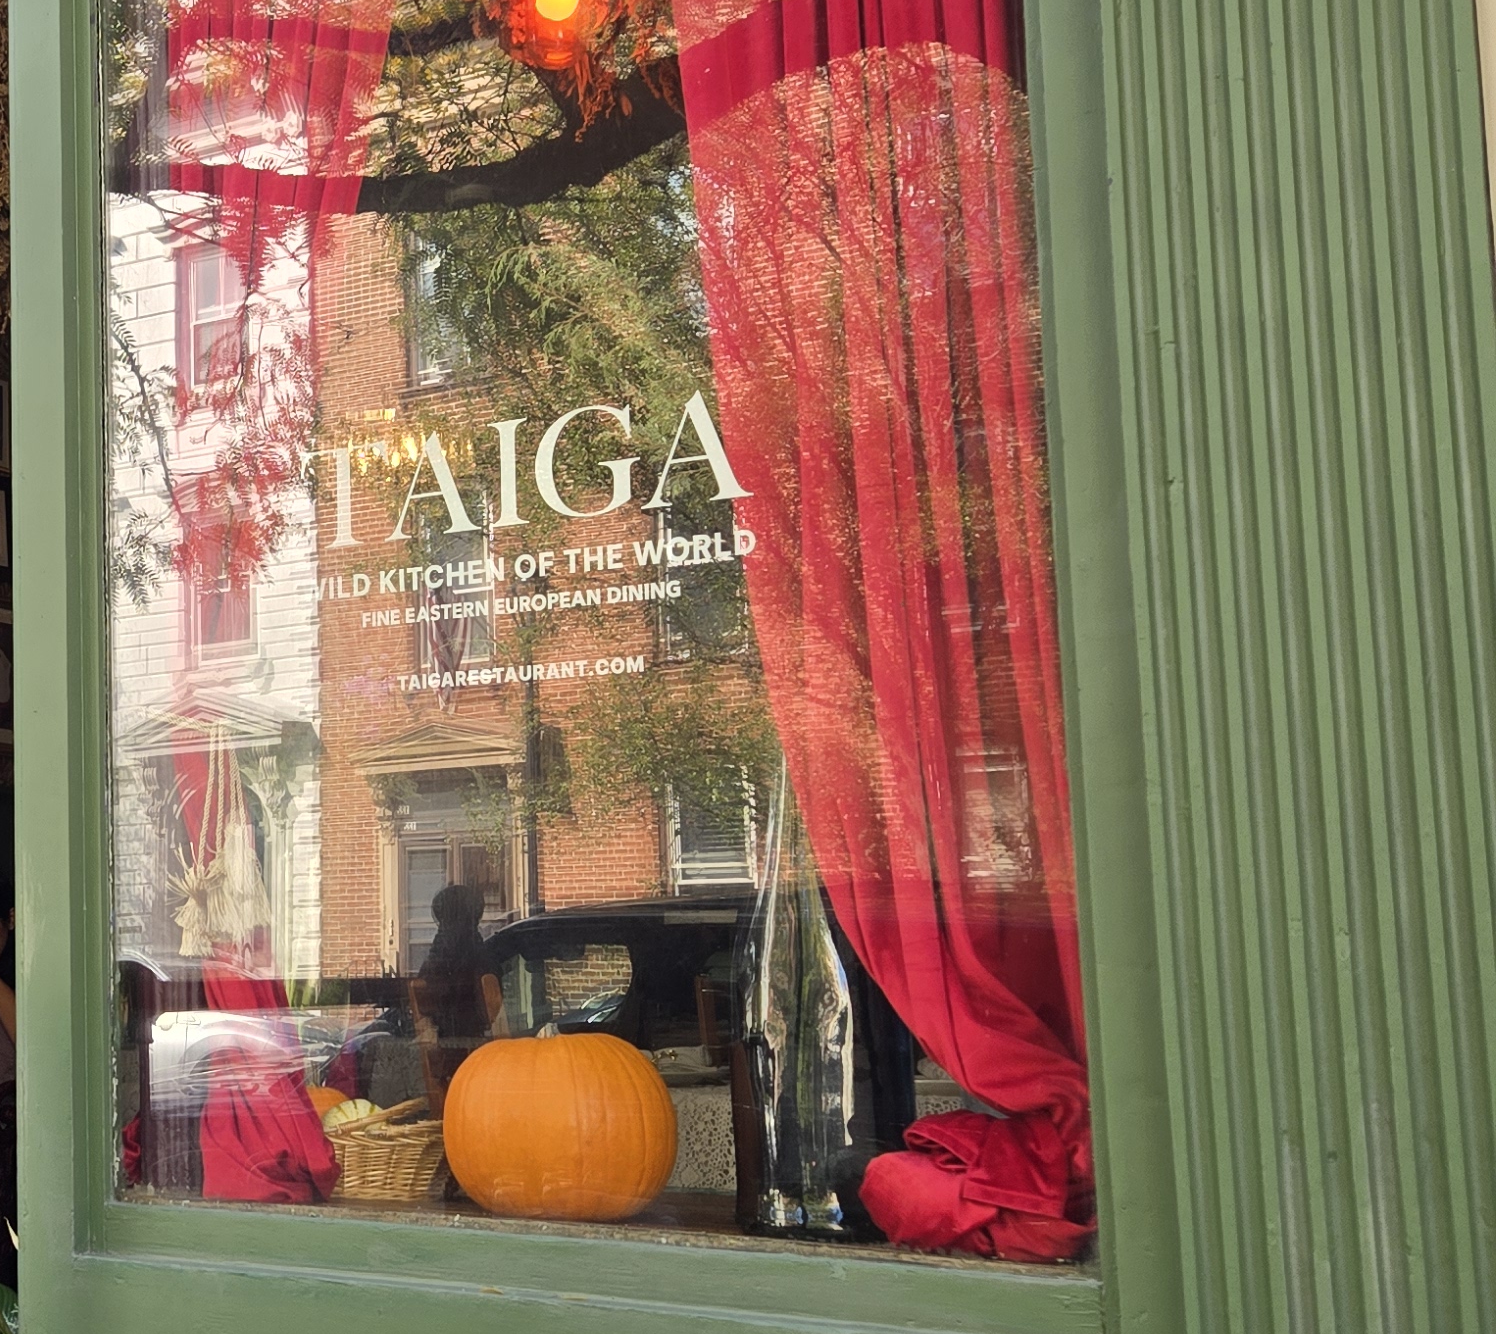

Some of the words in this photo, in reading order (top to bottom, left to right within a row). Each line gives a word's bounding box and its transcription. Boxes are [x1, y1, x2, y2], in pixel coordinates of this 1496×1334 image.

[300, 388, 754, 550] TAIGA
[379, 556, 505, 595] KITCHEN
[514, 551, 555, 580] OF
[563, 543, 624, 574] THE
[632, 529, 757, 567] WORLD
[361, 608, 401, 629] FINE
[405, 599, 489, 624] EASTERN
[494, 588, 602, 615] EUROPEAN
[606, 580, 682, 604] DINING
[396, 655, 646, 692] TAIGARESTAURANT.COM
